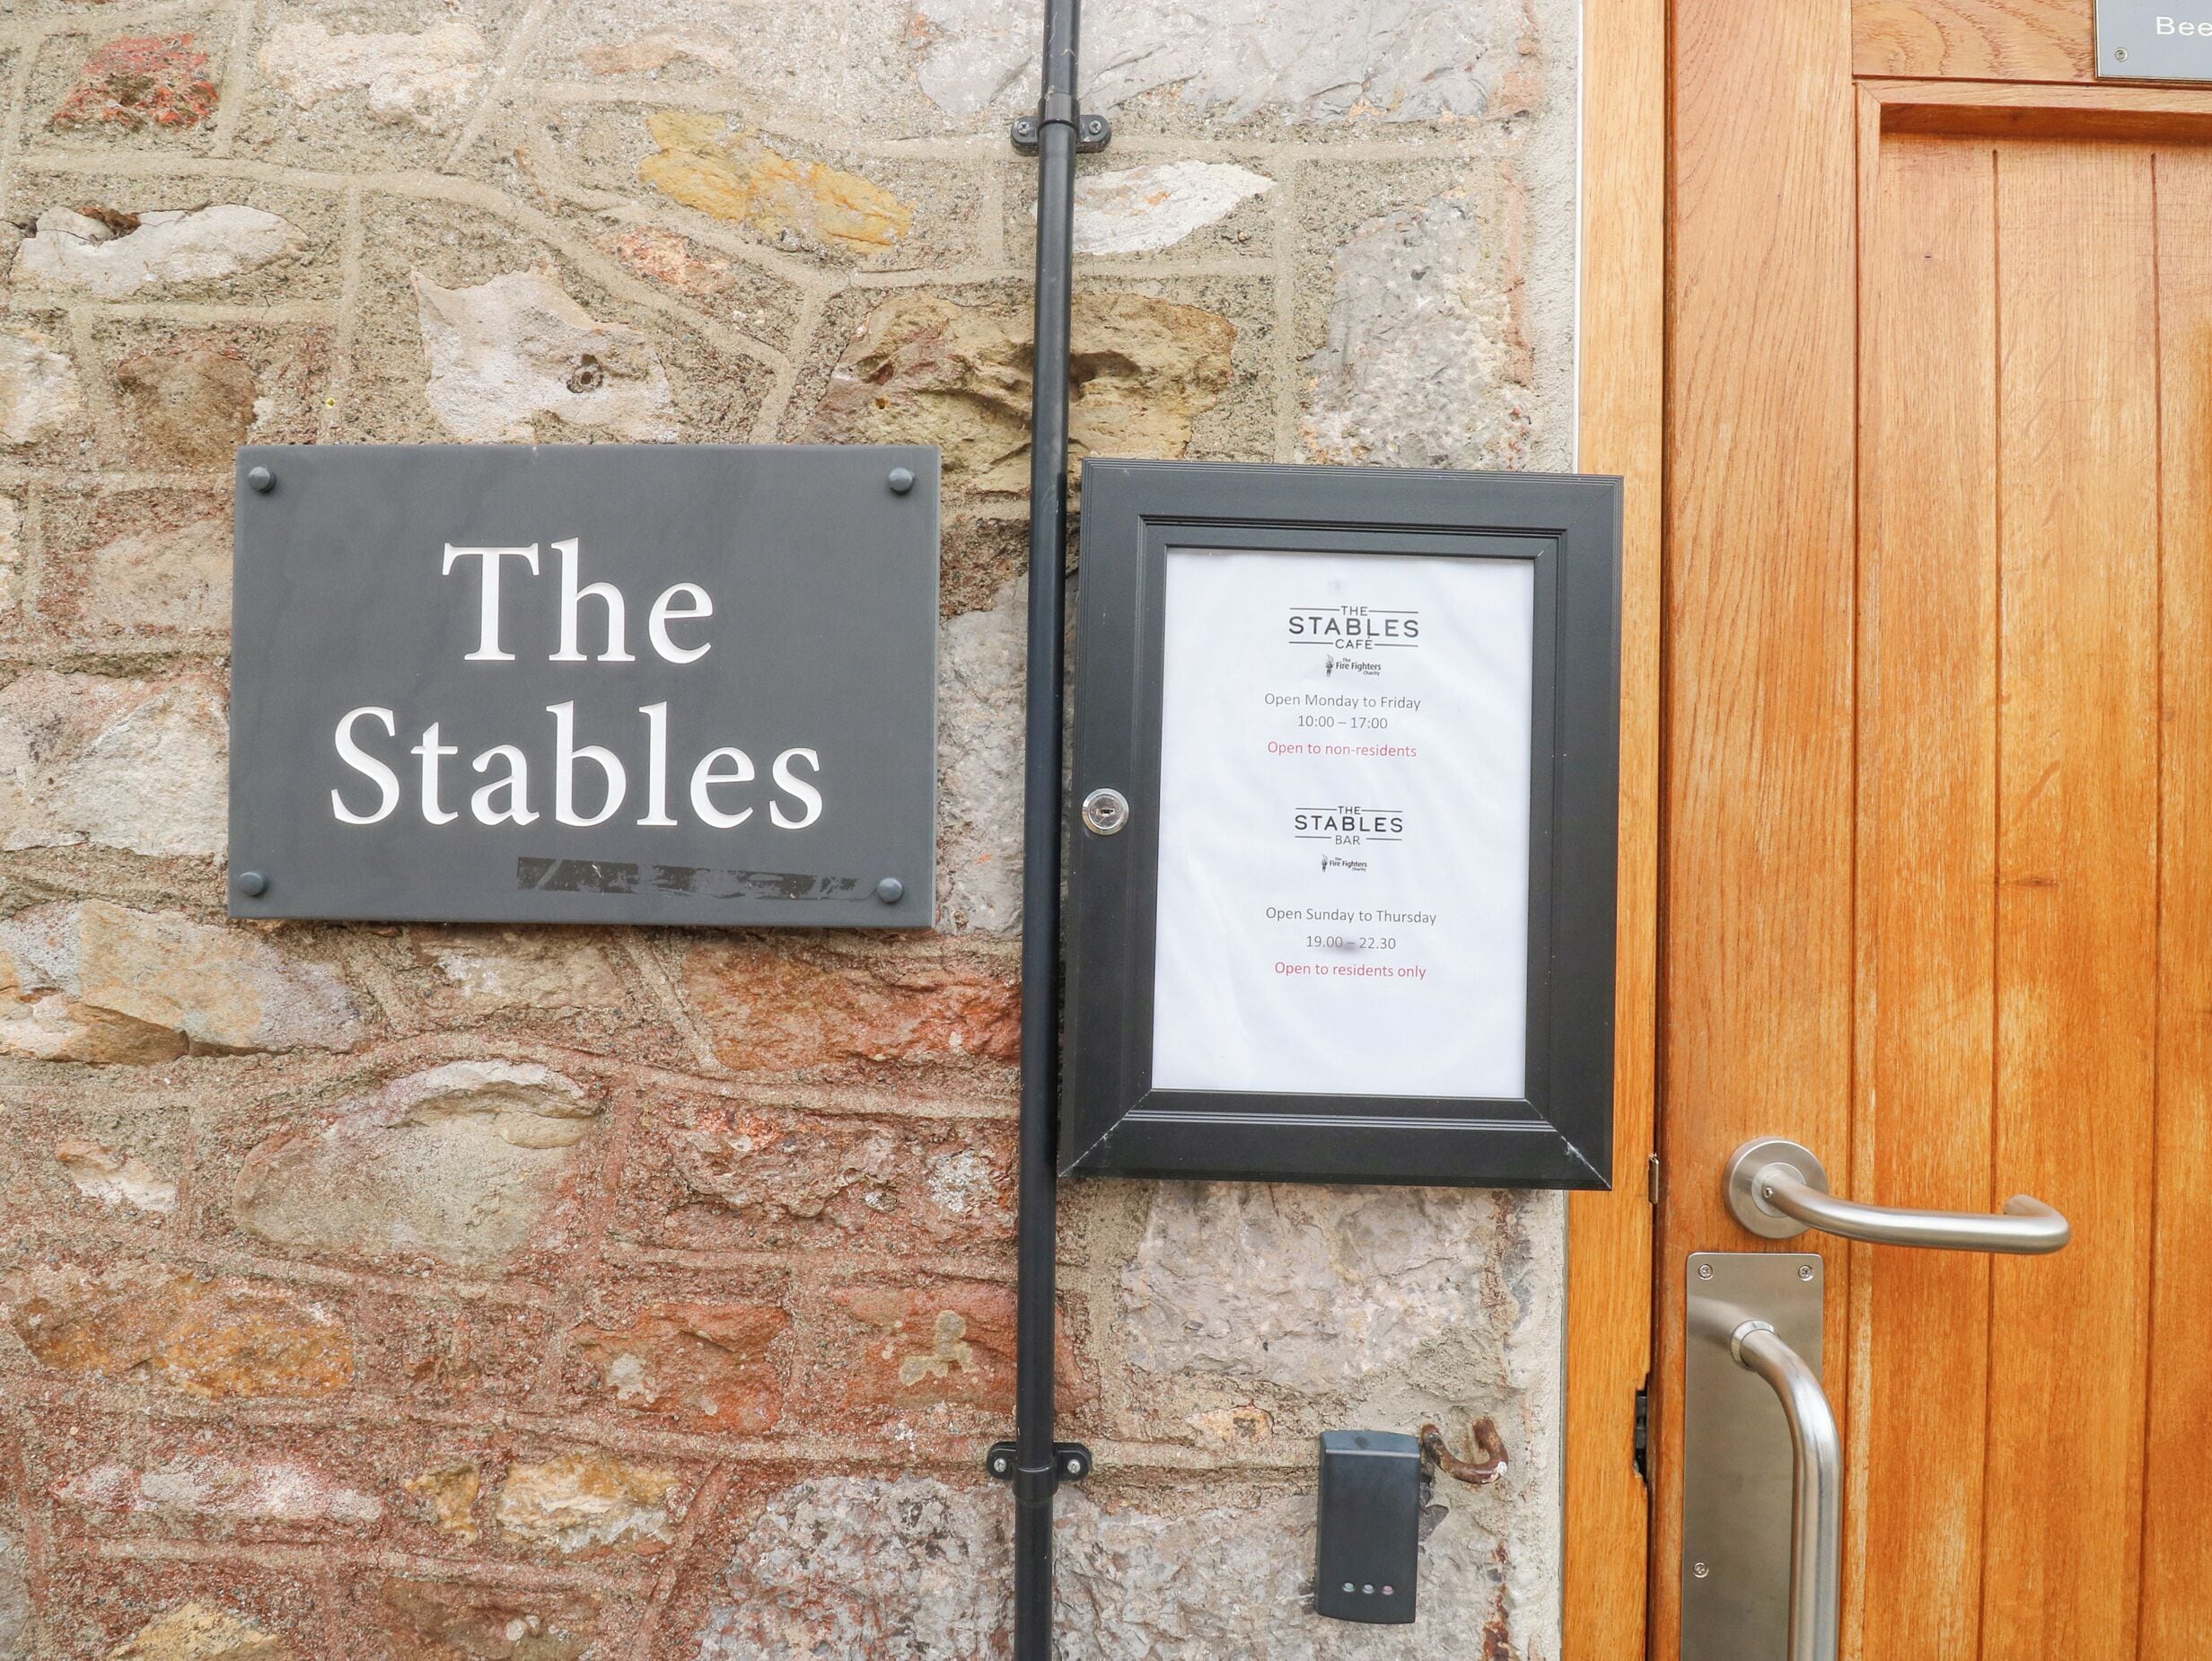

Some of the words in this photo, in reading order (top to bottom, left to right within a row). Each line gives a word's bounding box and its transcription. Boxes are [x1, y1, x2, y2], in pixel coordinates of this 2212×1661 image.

[442, 537, 714, 664] The
[1340, 605, 1368, 616] THE
[1288, 616, 1419, 637] STABLES
[1335, 636, 1374, 650] CAFÉ
[1335, 661, 1350, 670] Fire
[1351, 662, 1382, 672] Fighters
[1264, 693, 1301, 707] Open
[1304, 694, 1359, 709] Monday
[1363, 696, 1376, 708] to
[1380, 697, 1421, 712] Friday
[1298, 716, 1335, 728] 10:00
[1350, 717, 1388, 730] 17:00
[1267, 742, 1304, 756] Open
[1307, 743, 1321, 755] to
[1325, 744, 1417, 757] non-residents
[330, 699, 823, 830] Stables
[1338, 805, 1361, 815] THE
[1295, 815, 1403, 833] STABLES
[1335, 835, 1361, 846] BAR
[1266, 907, 1303, 920] Open
[1306, 908, 1356, 923] Sunday
[1358, 910, 1373, 923] to
[1376, 910, 1437, 927] Thursday
[1306, 936, 1343, 948] 19.00
[1359, 937, 1396, 950] 22.30
[1275, 962, 1311, 975] Open
[1315, 963, 1329, 975] to
[1333, 963, 1394, 977] residents
[1397, 966, 1427, 980] only
